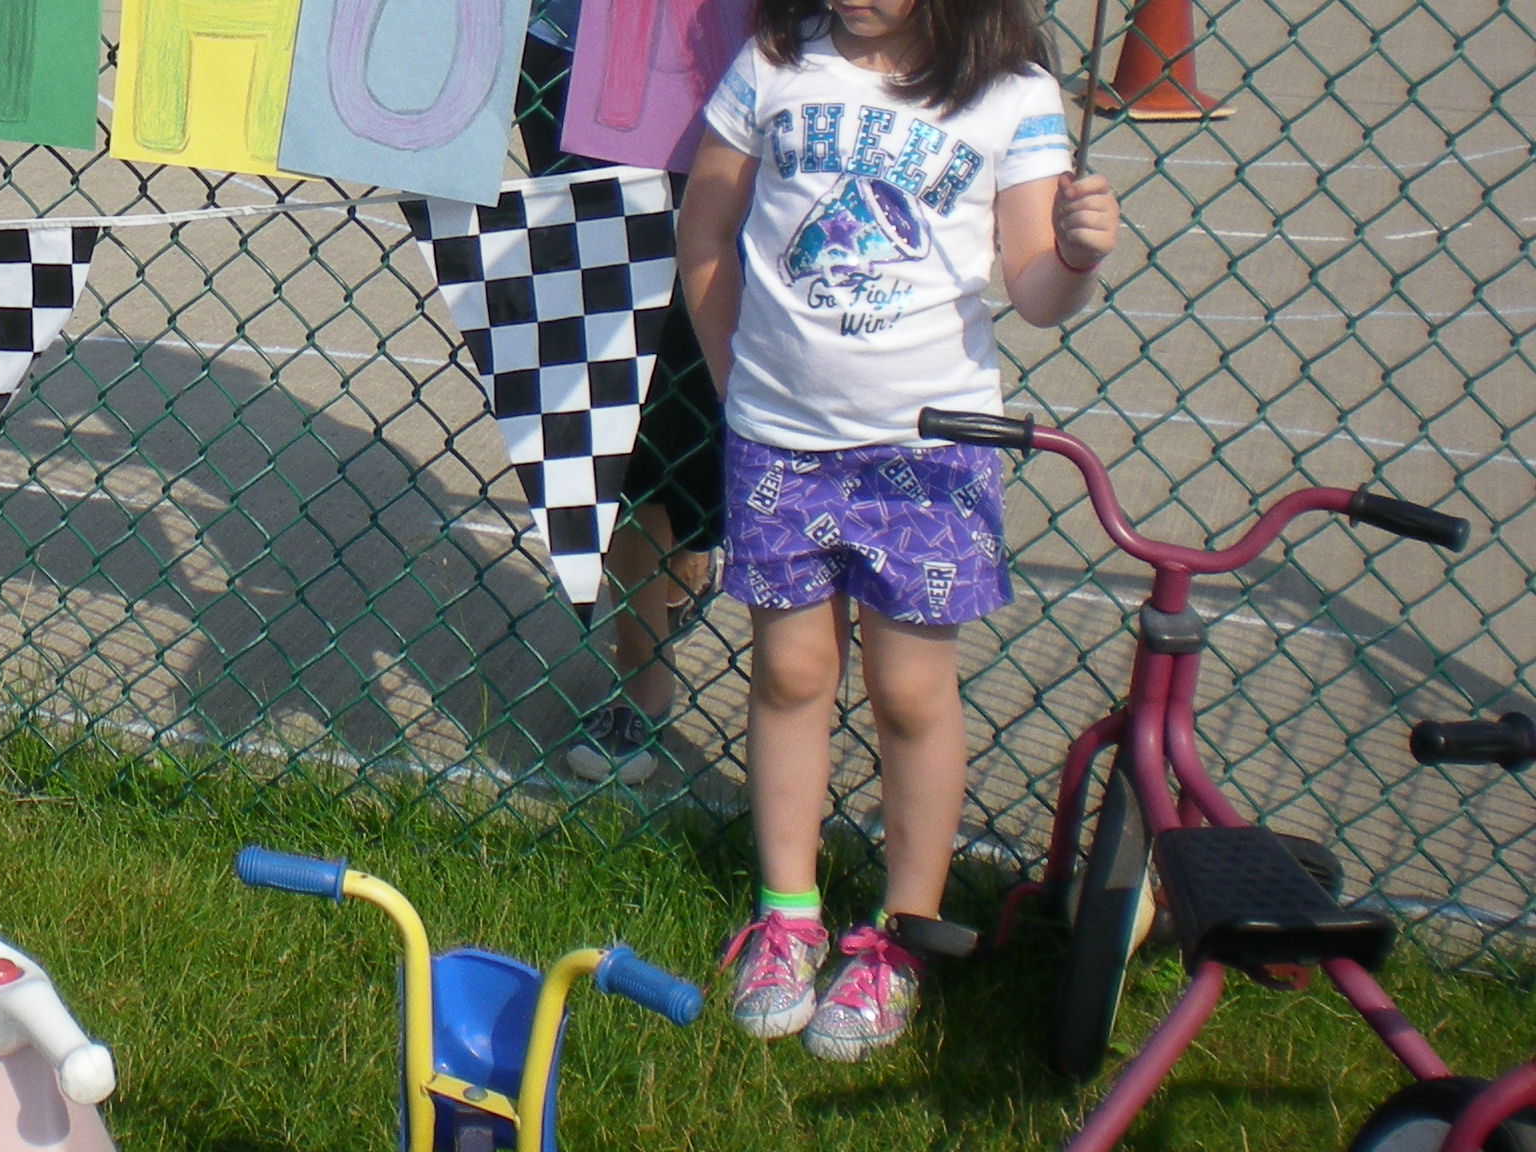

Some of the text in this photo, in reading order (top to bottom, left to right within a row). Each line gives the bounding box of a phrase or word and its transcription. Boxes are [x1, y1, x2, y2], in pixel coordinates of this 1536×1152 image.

[771, 102, 985, 218] CHEER
[807, 273, 913, 310] Go Fight
[839, 307, 902, 337] Win!
